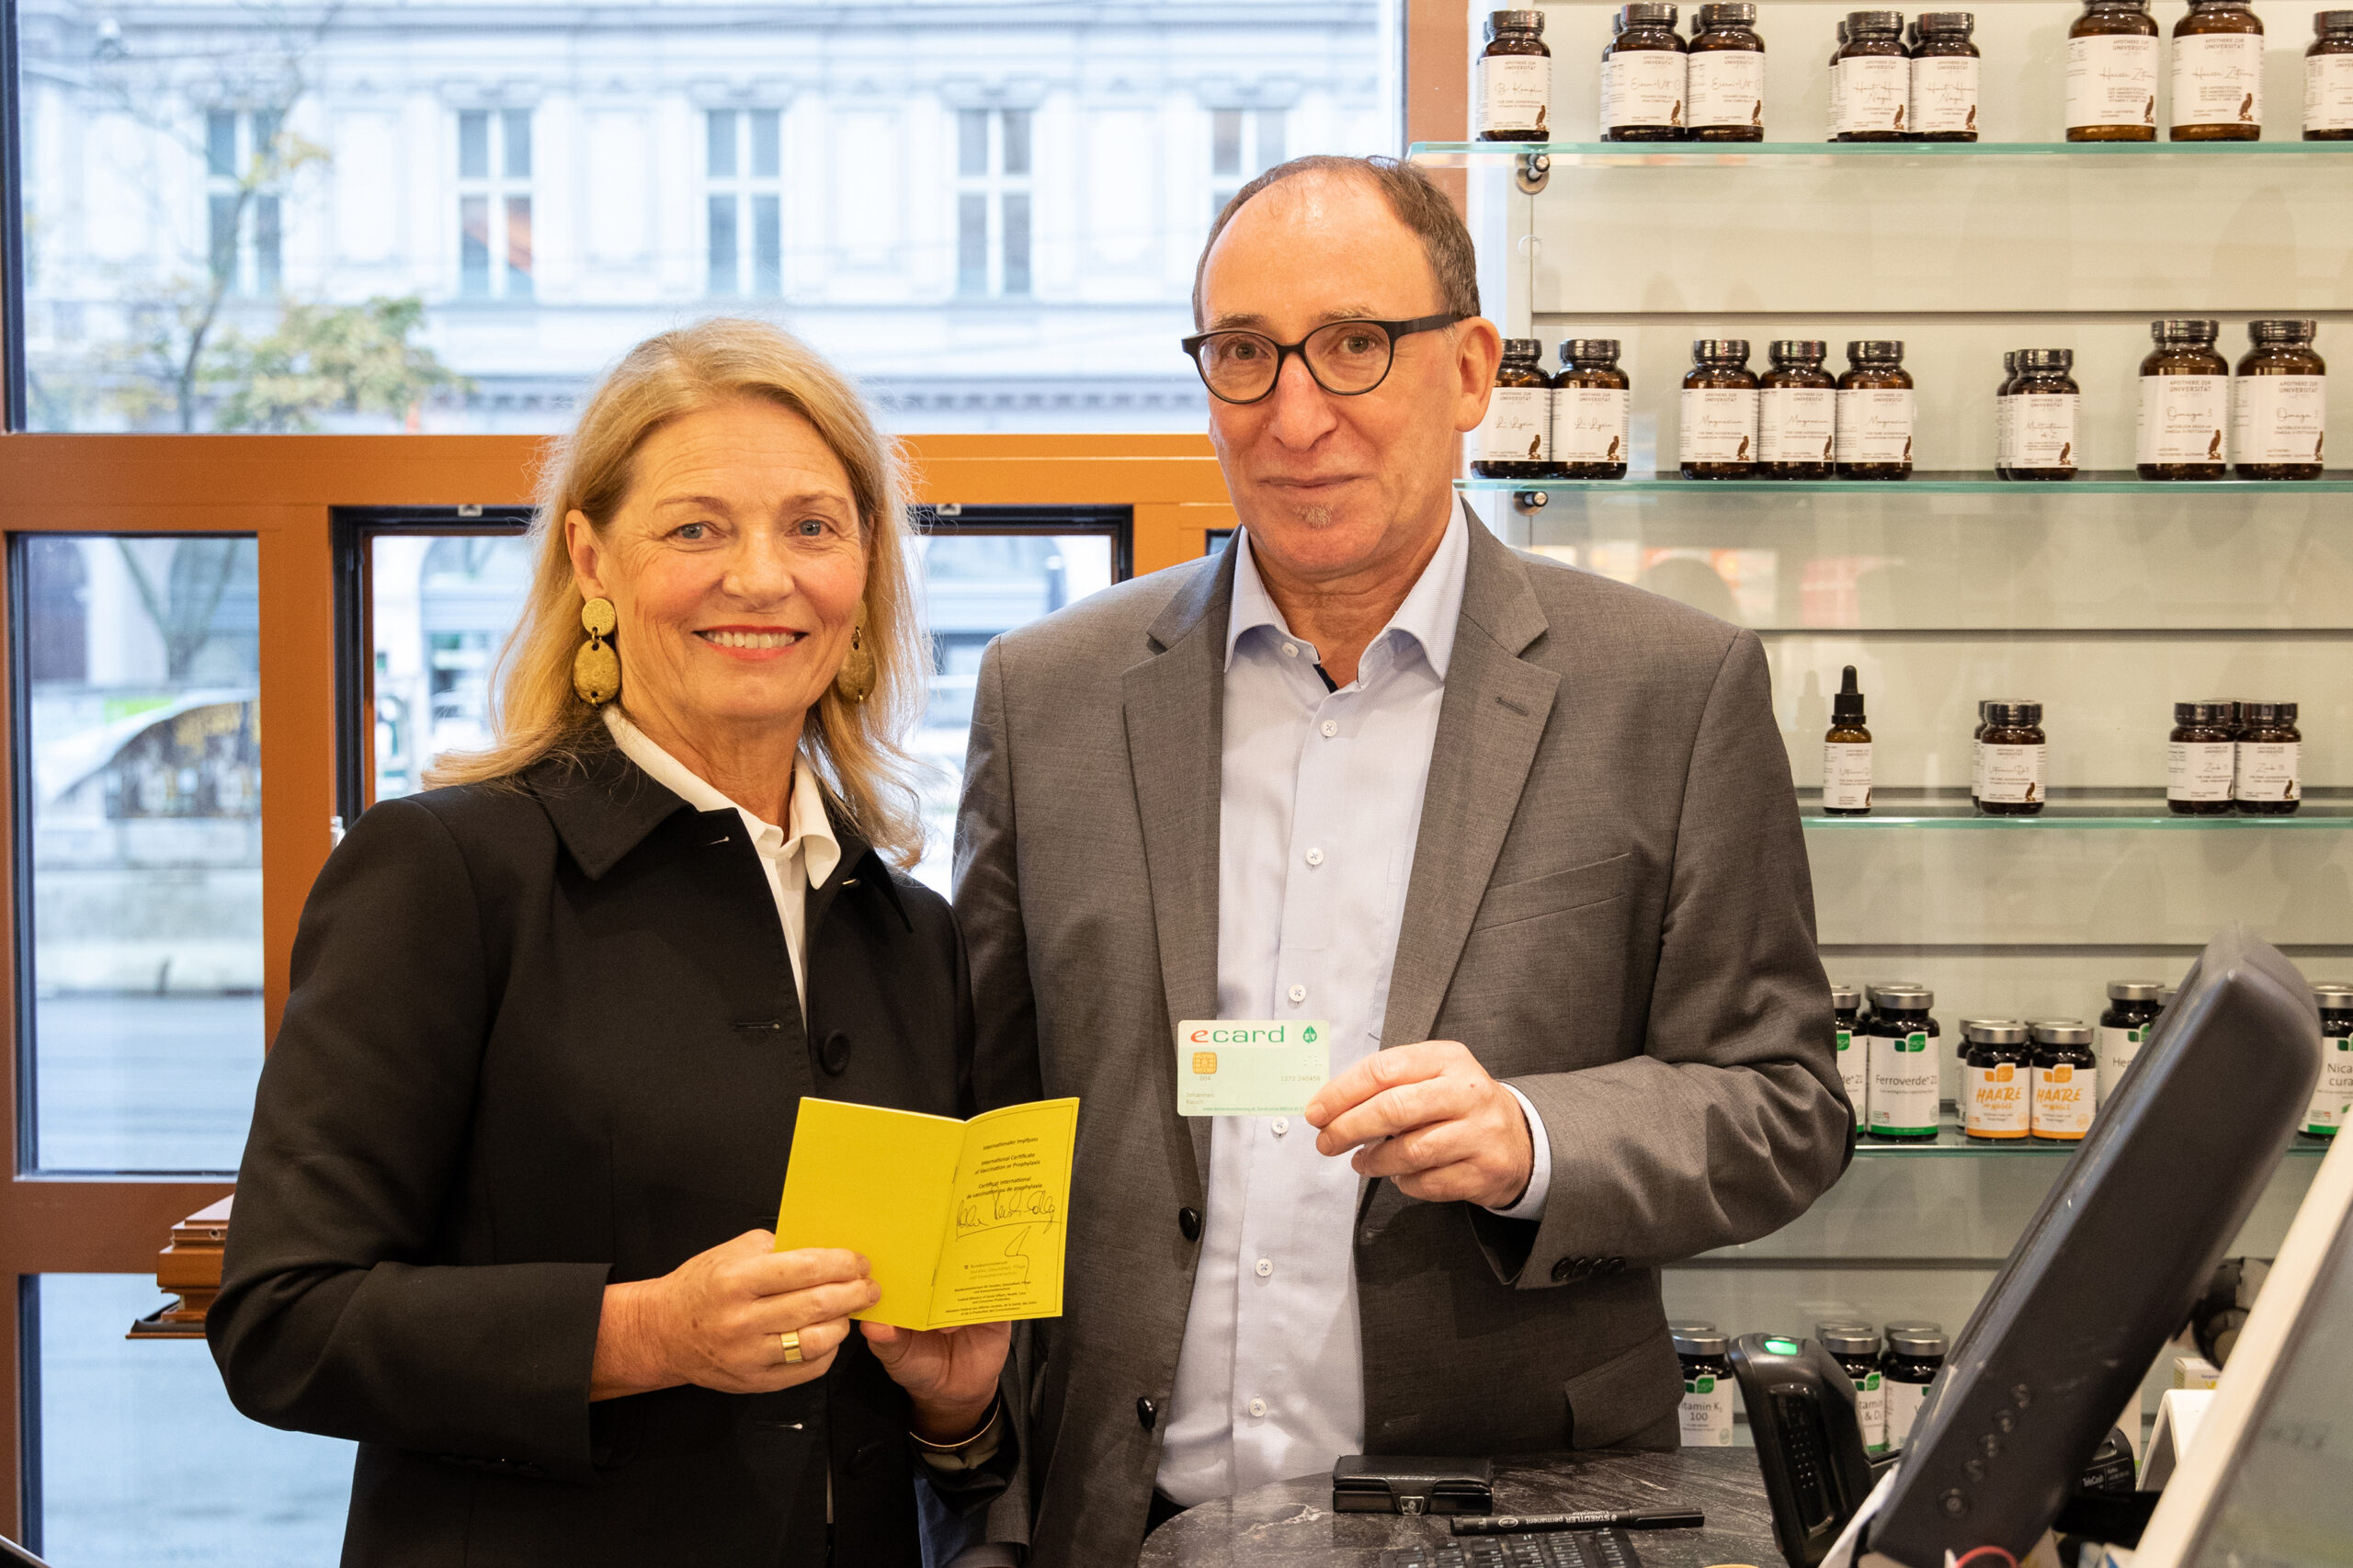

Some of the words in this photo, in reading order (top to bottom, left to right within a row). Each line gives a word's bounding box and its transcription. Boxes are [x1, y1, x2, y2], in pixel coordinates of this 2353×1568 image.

[2166, 406, 2203, 422] Omega
[2277, 407, 2311, 422] Omega
[1976, 1086, 2022, 1103] HAARE
[2036, 1088, 2083, 1103] HAARE
[983, 1141, 1016, 1150] Internationaler
[980, 1165, 1006, 1174] Vaccination
[1012, 1160, 1040, 1168] Prophylaxis
[981, 1156, 1011, 1166] International
[978, 1180, 999, 1189] Certificat
[1000, 1176, 1031, 1185] international
[972, 1189, 998, 1198] vaccination
[1013, 1183, 1042, 1191] prophylaxie
[1689, 1412, 1709, 1421] 100
[1525, 1516, 1563, 1525] permanent
[1565, 1514, 1610, 1524] STAEDTLER
